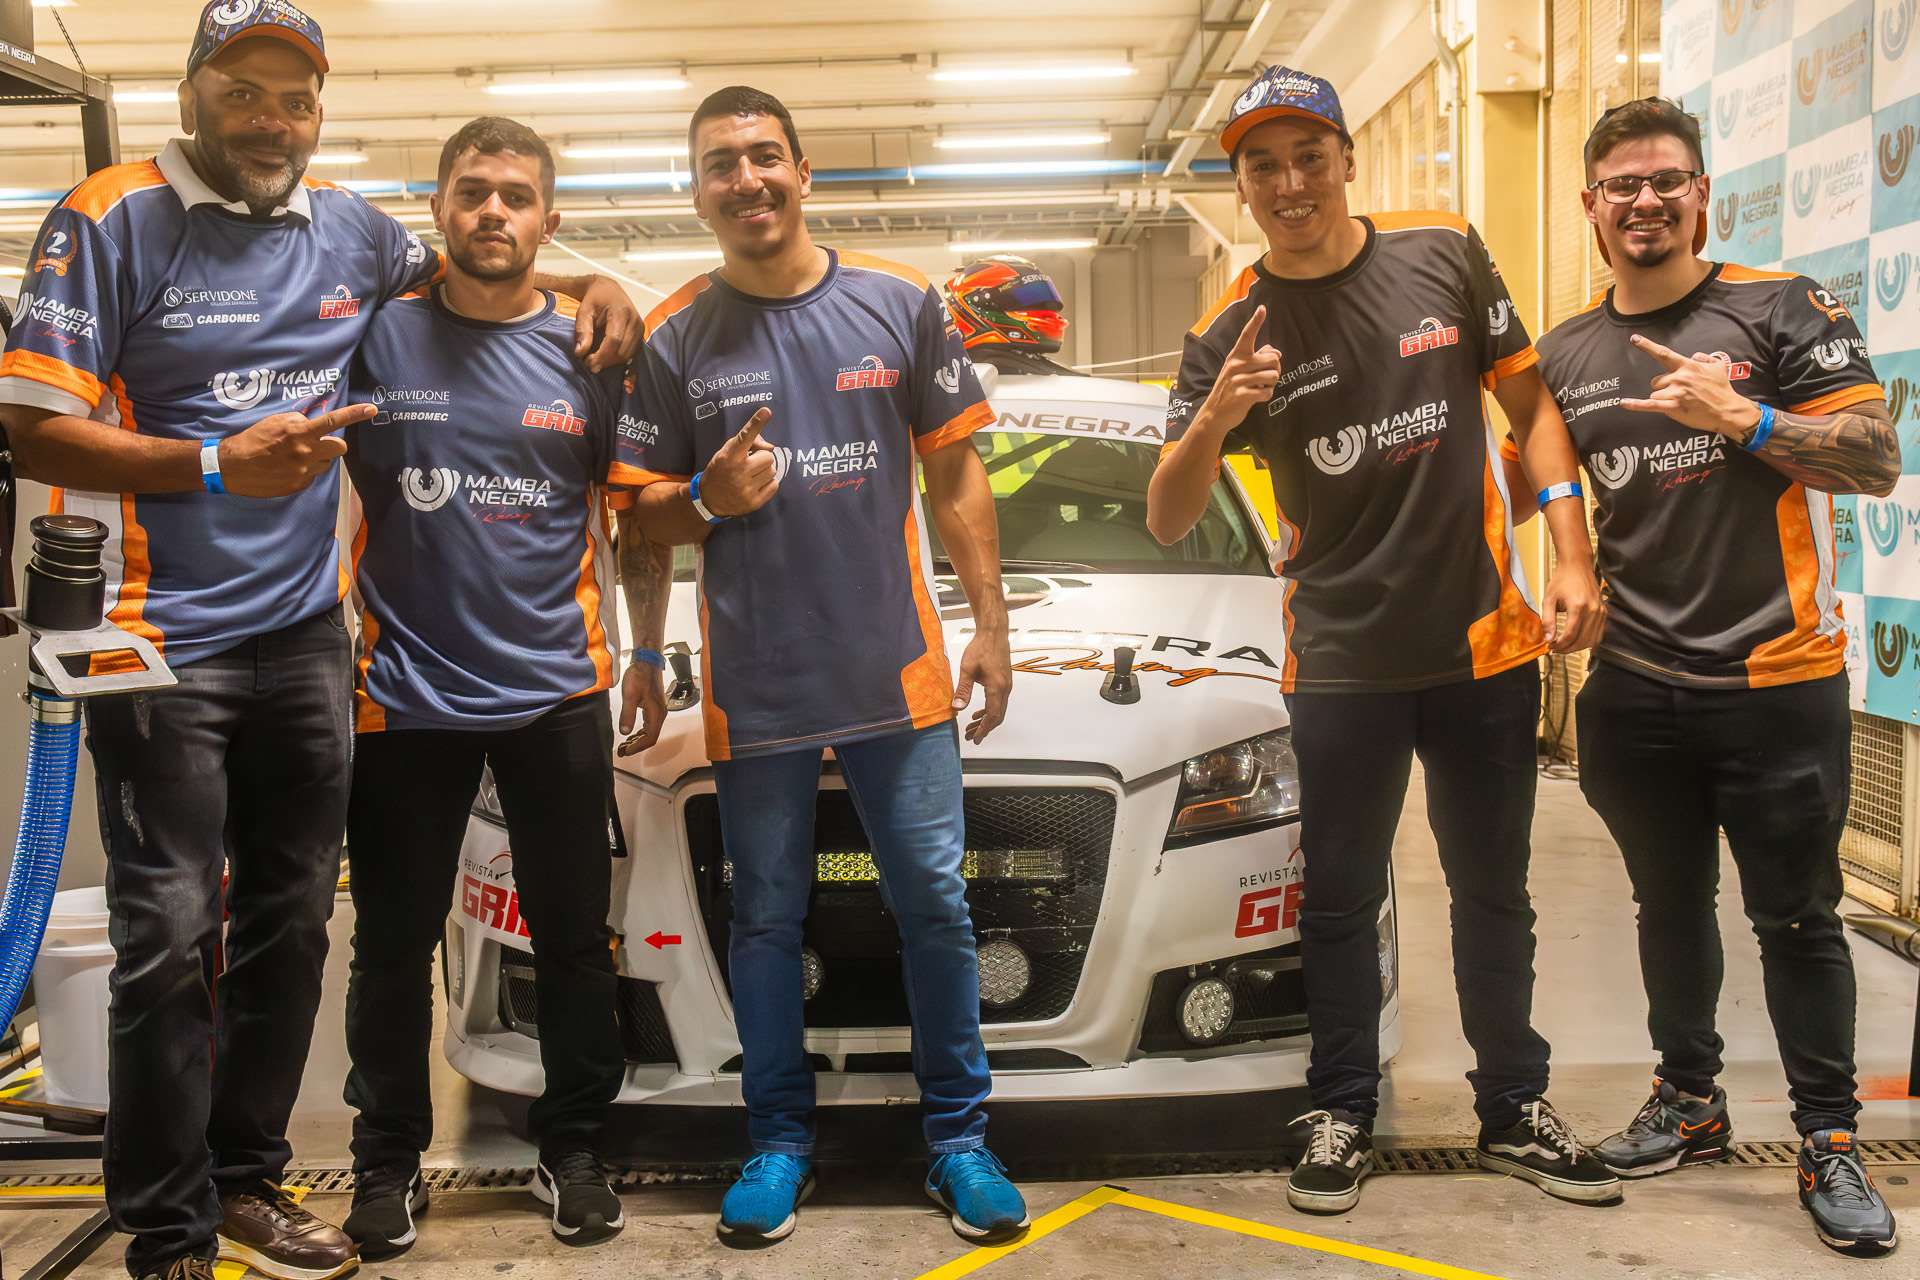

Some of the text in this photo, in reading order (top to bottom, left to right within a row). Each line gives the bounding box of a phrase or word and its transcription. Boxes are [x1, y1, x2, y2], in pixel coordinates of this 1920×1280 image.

[11, 46, 37, 66] NEGRA
[1273, 76, 1320, 91] MAMBA
[1276, 82, 1318, 94] NEGRA
[1824, 150, 1868, 181] MAMBA
[1740, 182, 1782, 209] MAMBA
[1825, 171, 1864, 200] NEGRA
[1741, 201, 1778, 225] NEGRA
[46, 231, 67, 255] 2
[184, 289, 258, 304] SERVIDONE
[1815, 289, 1838, 307] 2
[29, 307, 93, 340] NEGRA
[33, 297, 98, 328] MAMBA
[196, 313, 261, 325] CARBOMEC
[1399, 326, 1459, 358] GRID
[1400, 328, 1426, 340] REVISTA
[276, 367, 342, 385] MAMB
[838, 364, 866, 373] REVISTA
[1277, 354, 1333, 388] SERVIDONE
[706, 370, 771, 392] SERVIDONE
[836, 369, 900, 392] GRID
[1287, 374, 1339, 403] CARBOMEC
[1569, 376, 1620, 400] SERVIDONE
[387, 389, 450, 402] SERVIDONE
[718, 391, 773, 409] CARBOMEC
[1576, 397, 1621, 417] CARBOMEC
[392, 411, 449, 422] CARBOMEC
[527, 403, 557, 412] REVISTA
[1371, 400, 1449, 438] MAMBA
[521, 408, 588, 436] GRID
[618, 414, 659, 436] AMBA
[996, 412, 1165, 440] NEGRA
[1376, 416, 1447, 450] NEGRA
[616, 424, 655, 446] EGRA
[796, 439, 879, 464] MAMBA
[1643, 433, 1728, 461] MAMBA
[802, 455, 878, 478] NEGRA
[1649, 447, 1726, 474] NEGRA
[464, 474, 551, 493] MAMBA
[808, 473, 866, 496] Racing
[468, 490, 549, 508] NEGRA
[463, 857, 494, 880] REVISTA
[1239, 865, 1300, 888] REVISTA
[462, 873, 532, 939] GRI
[1829, 1131, 1852, 1144] NIKE
